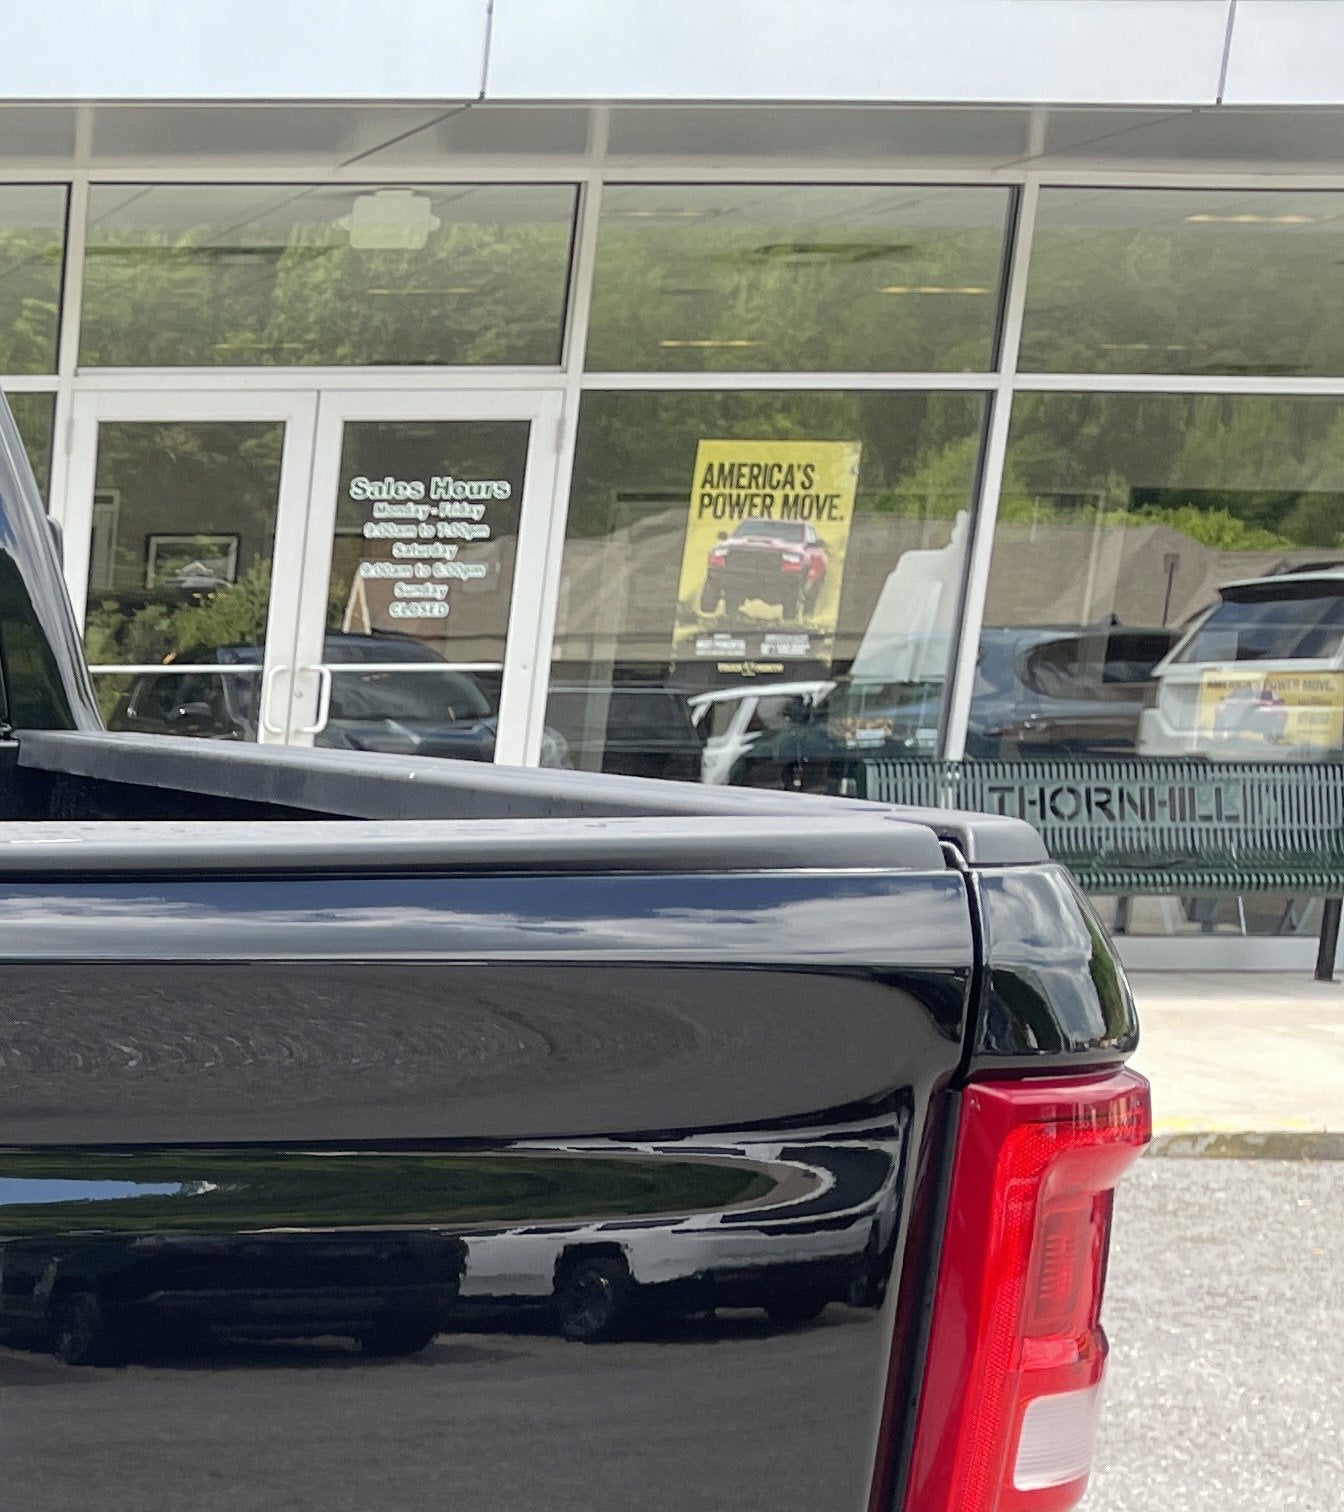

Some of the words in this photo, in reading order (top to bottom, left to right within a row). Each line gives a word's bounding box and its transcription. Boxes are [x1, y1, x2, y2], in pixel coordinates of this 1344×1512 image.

[349, 476, 426, 500] Sales
[429, 476, 511, 500] Hours
[701, 462, 816, 491] AMERICA'S
[697, 493, 772, 520] POWER
[780, 494, 845, 522] MOVE.
[391, 542, 459, 560] Saturday
[393, 581, 450, 601] Sunday
[388, 601, 450, 618] CLOSED
[988, 785, 1240, 824] THORNHILL
